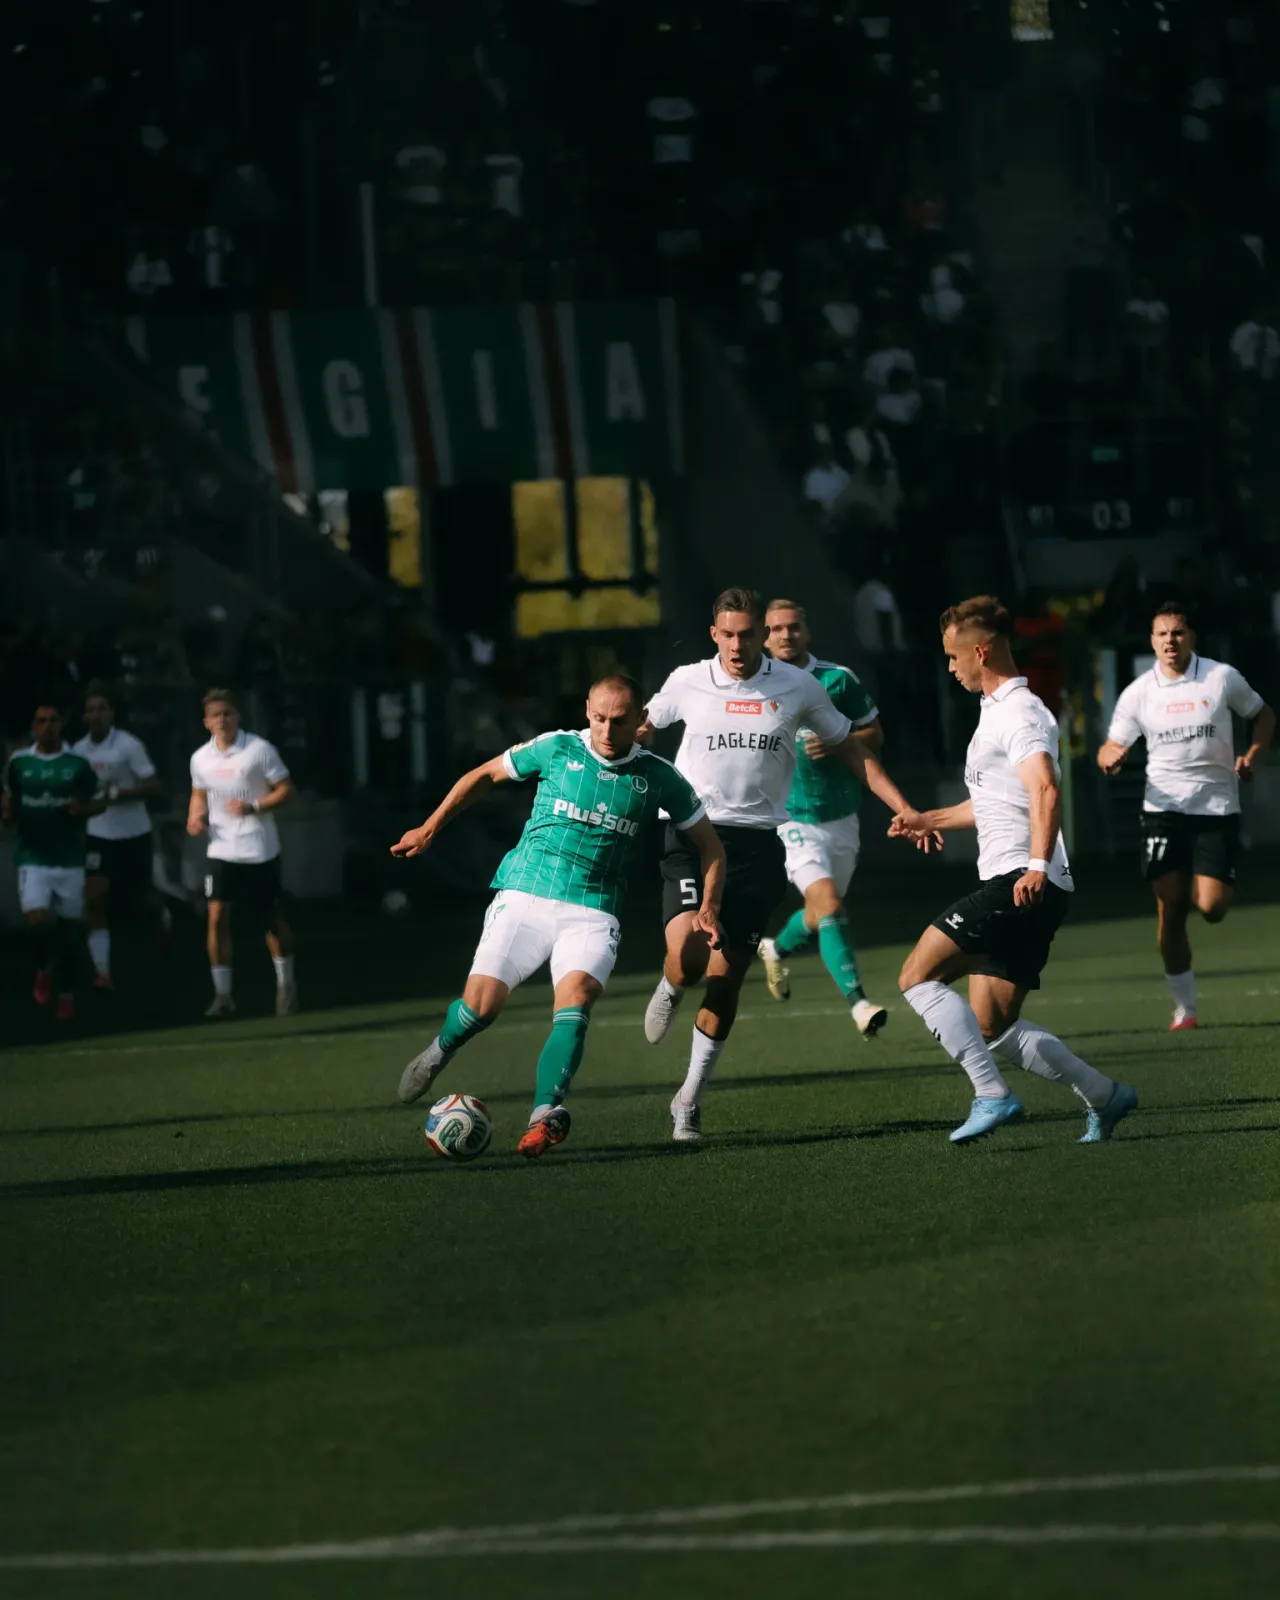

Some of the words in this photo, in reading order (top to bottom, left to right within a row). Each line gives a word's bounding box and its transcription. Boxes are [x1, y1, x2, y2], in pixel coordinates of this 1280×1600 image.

[728, 703, 759, 713] Betclic
[706, 732, 782, 752] ZAGŁĘBIE
[553, 798, 639, 837] Plus500
[679, 878, 698, 905] 5
